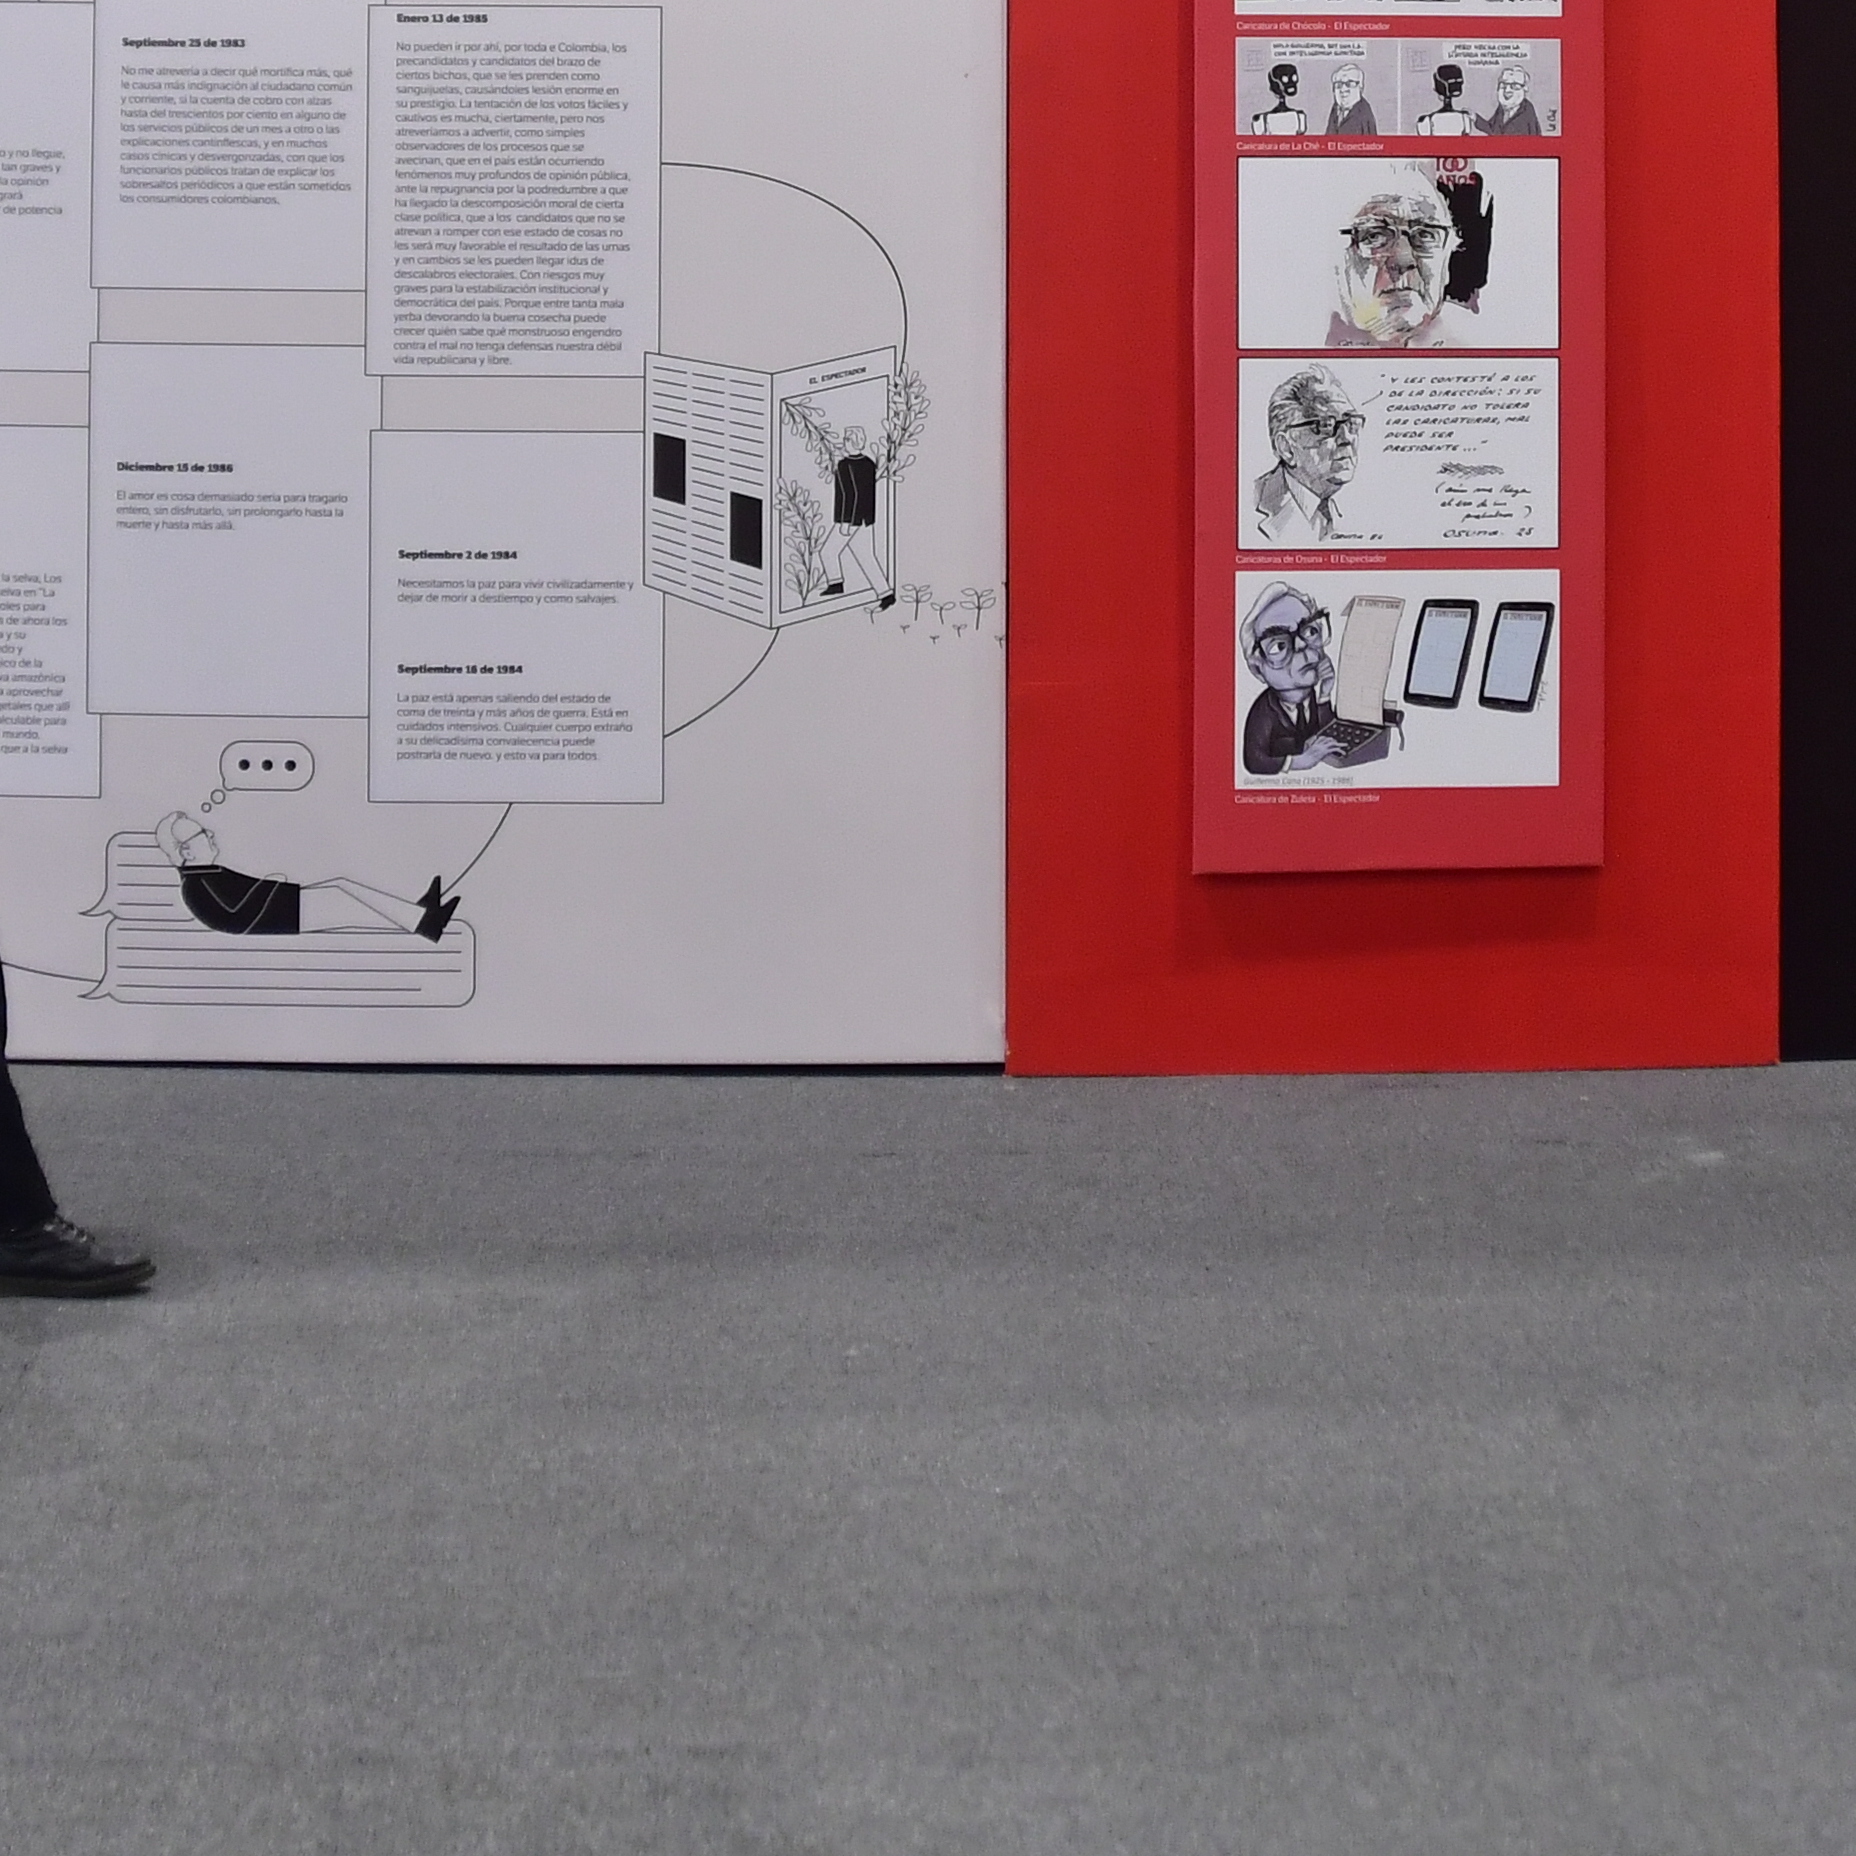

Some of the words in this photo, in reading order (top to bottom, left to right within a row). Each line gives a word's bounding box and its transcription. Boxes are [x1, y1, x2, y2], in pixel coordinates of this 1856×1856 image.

[396, 13, 429, 22] Enero
[432, 13, 443, 22] 13
[446, 14, 460, 22] de
[462, 14, 488, 23] 1985
[1236, 21, 1278, 30] Caricatura
[1279, 22, 1290, 30] de
[1334, 21, 1342, 30] El
[1344, 21, 1390, 30] Espectador
[122, 37, 186, 49] Septiembre
[203, 38, 217, 47] de
[220, 38, 245, 47] 1983
[1236, 142, 1278, 150] Caricatura
[1279, 142, 1290, 150] de
[1291, 142, 1301, 150] La
[1328, 142, 1335, 150] El
[1337, 142, 1383, 151] Espectador
[1386, 403, 1455, 412] CANDIDATO
[1384, 430, 1424, 438] PUEDE
[117, 462, 174, 471] Diciembre
[176, 463, 188, 472] 15
[190, 463, 204, 472] de
[207, 463, 233, 472] 1986
[116, 490, 126, 500] El
[128, 492, 154, 500] amor
[170, 493, 195, 501] cosa
[196, 492, 254, 502] demasiado
[256, 494, 281, 502] seria
[283, 495, 306, 503] para
[398, 549, 463, 561] Septiembre
[466, 550, 472, 559] 2
[474, 550, 488, 559] de
[490, 550, 517, 559] 1984
[1235, 554, 1281, 563] Caricaturas
[1283, 554, 1293, 563] de
[1295, 554, 1322, 563] Osuna
[1330, 554, 1338, 563] El
[1340, 554, 1386, 563] Espectador
[398, 578, 464, 588] Necesitamos
[466, 579, 475, 588] la
[478, 580, 496, 590] paz
[498, 580, 521, 590] para
[546, 579, 626, 589] civilizadamente
[626, 582, 634, 591] y
[397, 592, 423, 603] dejar
[425, 593, 438, 602] de
[441, 593, 468, 602] morir
[478, 593, 533, 604] destiempo
[535, 596, 541, 605] y
[543, 595, 573, 603] como
[398, 664, 462, 675] Septiembre
[480, 665, 494, 673] de
[496, 665, 522, 674] 1984
[1234, 794, 1276, 803] Caricatura
[1323, 794, 1332, 802] El
[1333, 793, 1379, 803] Espectador
